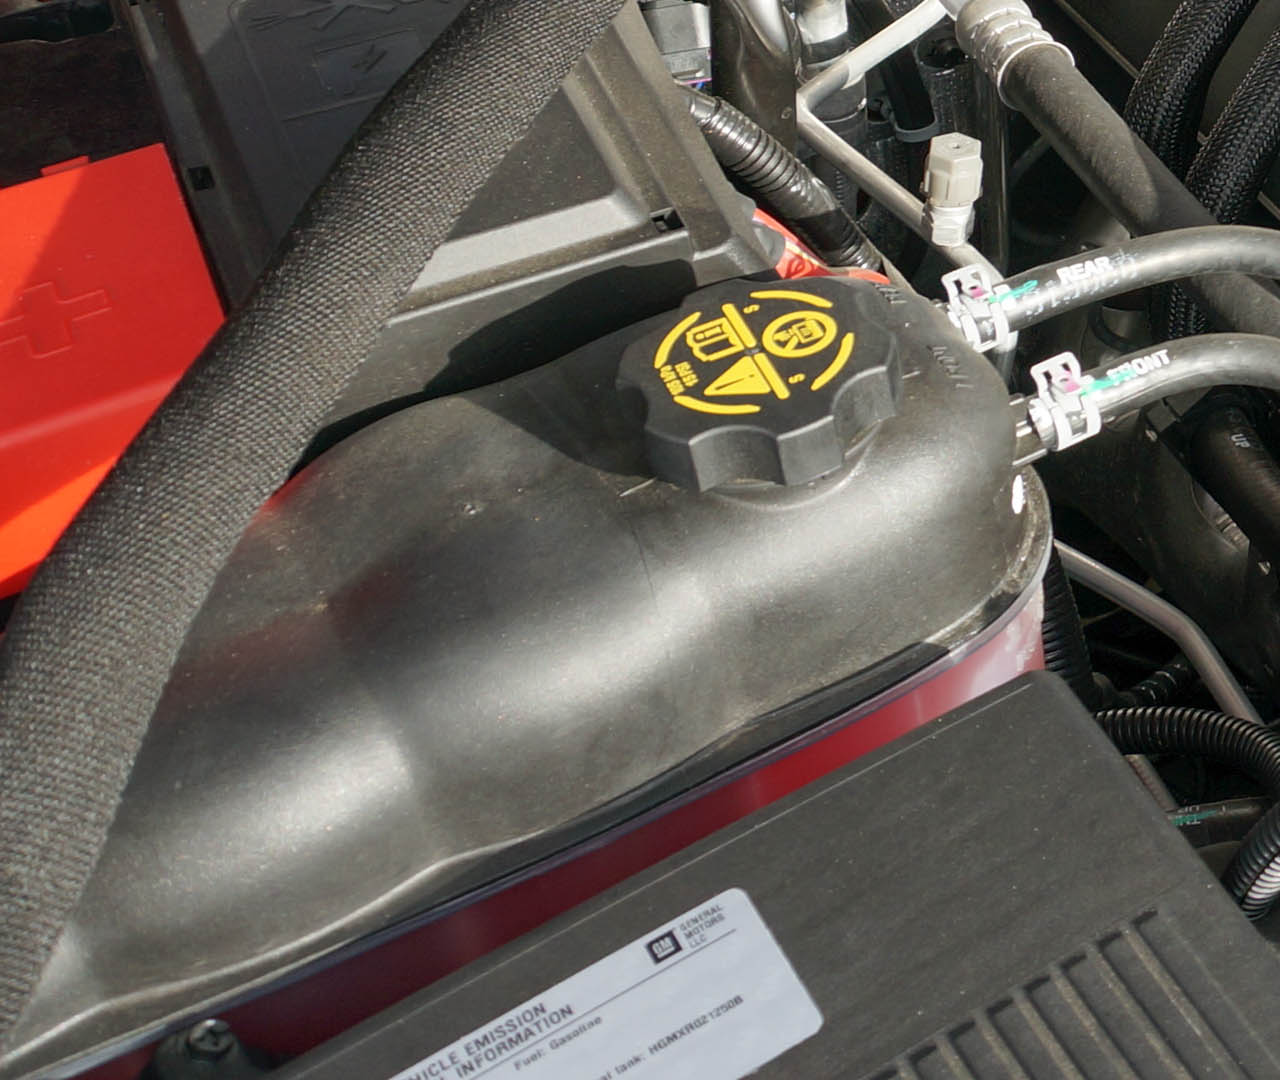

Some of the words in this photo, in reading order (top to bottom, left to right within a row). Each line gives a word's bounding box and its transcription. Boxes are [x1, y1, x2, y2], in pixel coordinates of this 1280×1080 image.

[1056, 256, 1115, 284] REAR
[680, 905, 724, 931] GENERAL
[684, 913, 726, 939] MOTORS
[455, 1004, 575, 1078] INFORMATION
[463, 1002, 547, 1056] EMISSION
[549, 1016, 603, 1051] Gasoline
